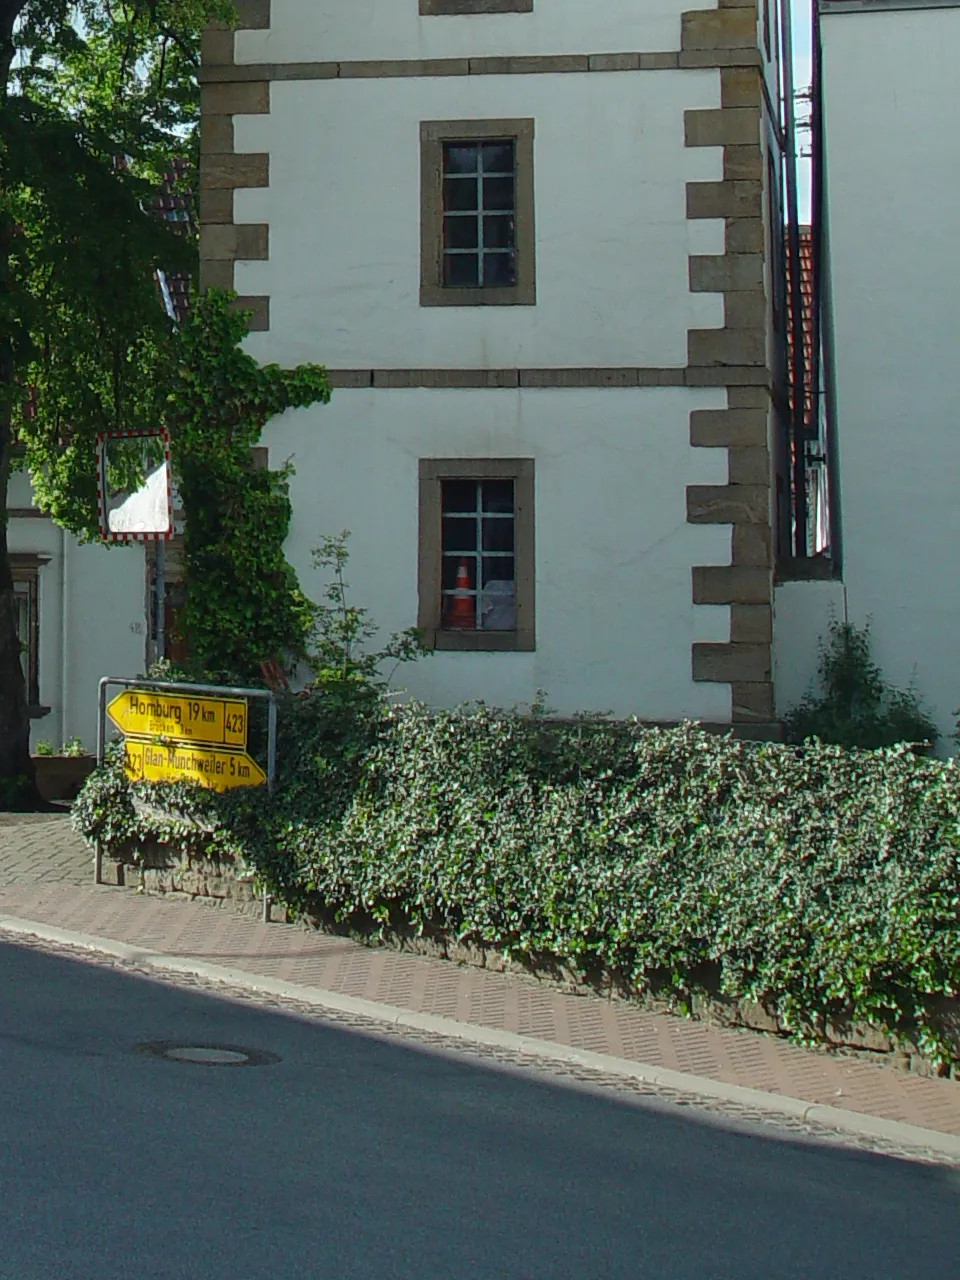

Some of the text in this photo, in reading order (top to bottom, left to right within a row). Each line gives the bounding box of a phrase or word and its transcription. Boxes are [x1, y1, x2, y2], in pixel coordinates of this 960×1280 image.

[129, 695, 216, 724] Homburg 19 km
[185, 727, 193, 736] km
[226, 713, 244, 734] 423
[229, 756, 236, 776] 5
[237, 763, 250, 779] km
